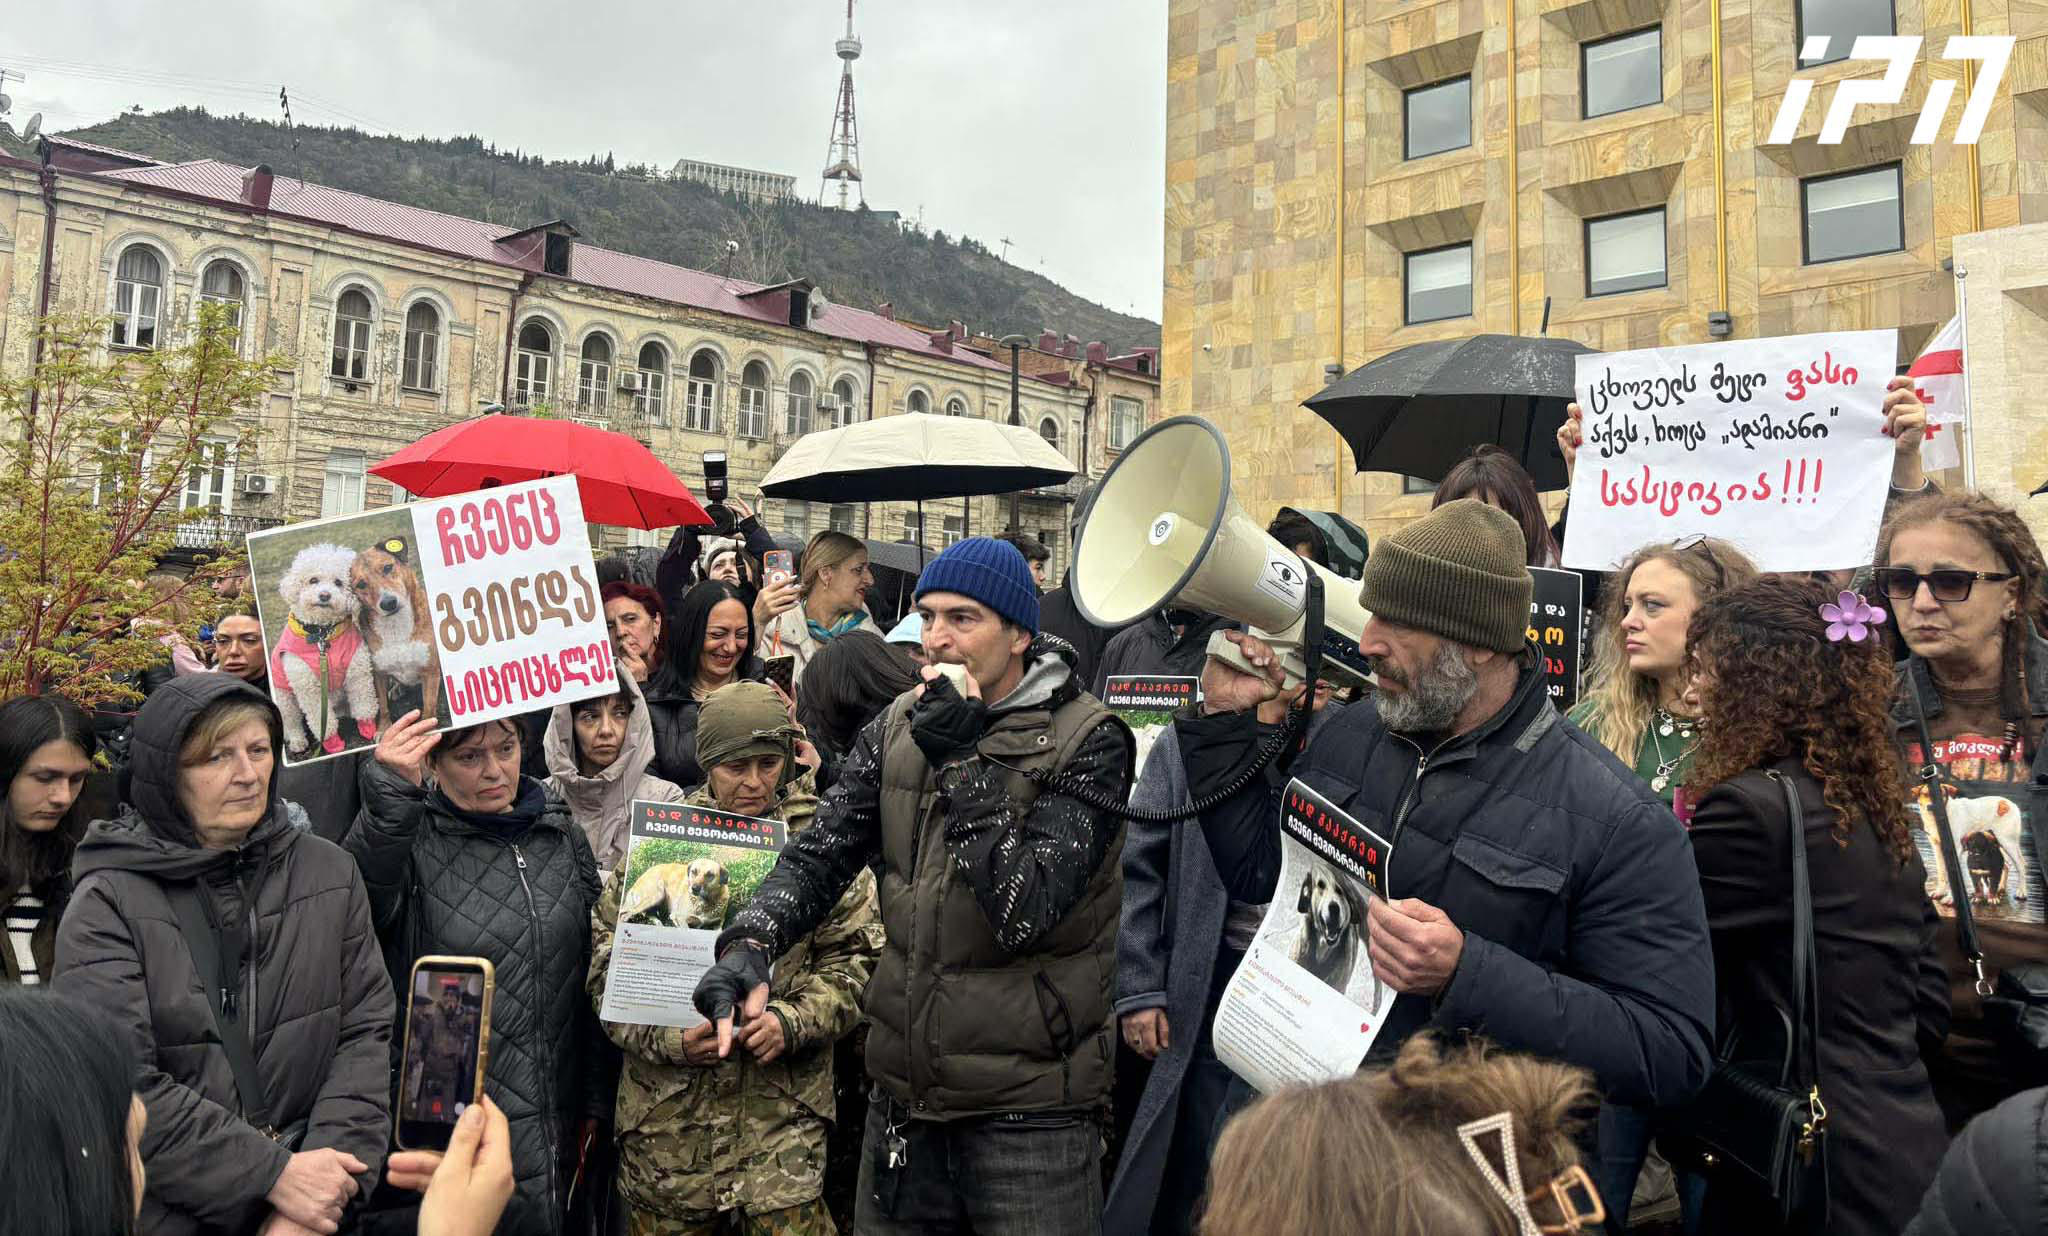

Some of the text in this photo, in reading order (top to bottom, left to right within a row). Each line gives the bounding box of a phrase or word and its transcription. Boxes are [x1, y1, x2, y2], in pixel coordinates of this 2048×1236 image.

[1590, 351, 1858, 415] ცხოველს მეტი ფასი
[1600, 458, 1824, 517] სასტიკია!!!
[436, 487, 561, 567] ჩვენც
[435, 565, 596, 652] გვინდა
[445, 639, 615, 716] სიცოცხლე!
[645, 821, 685, 835] ჩვენი
[687, 827, 761, 845] მეგობრები
[646, 808, 682, 821] სად
[1287, 814, 1312, 842] ჩვენი
